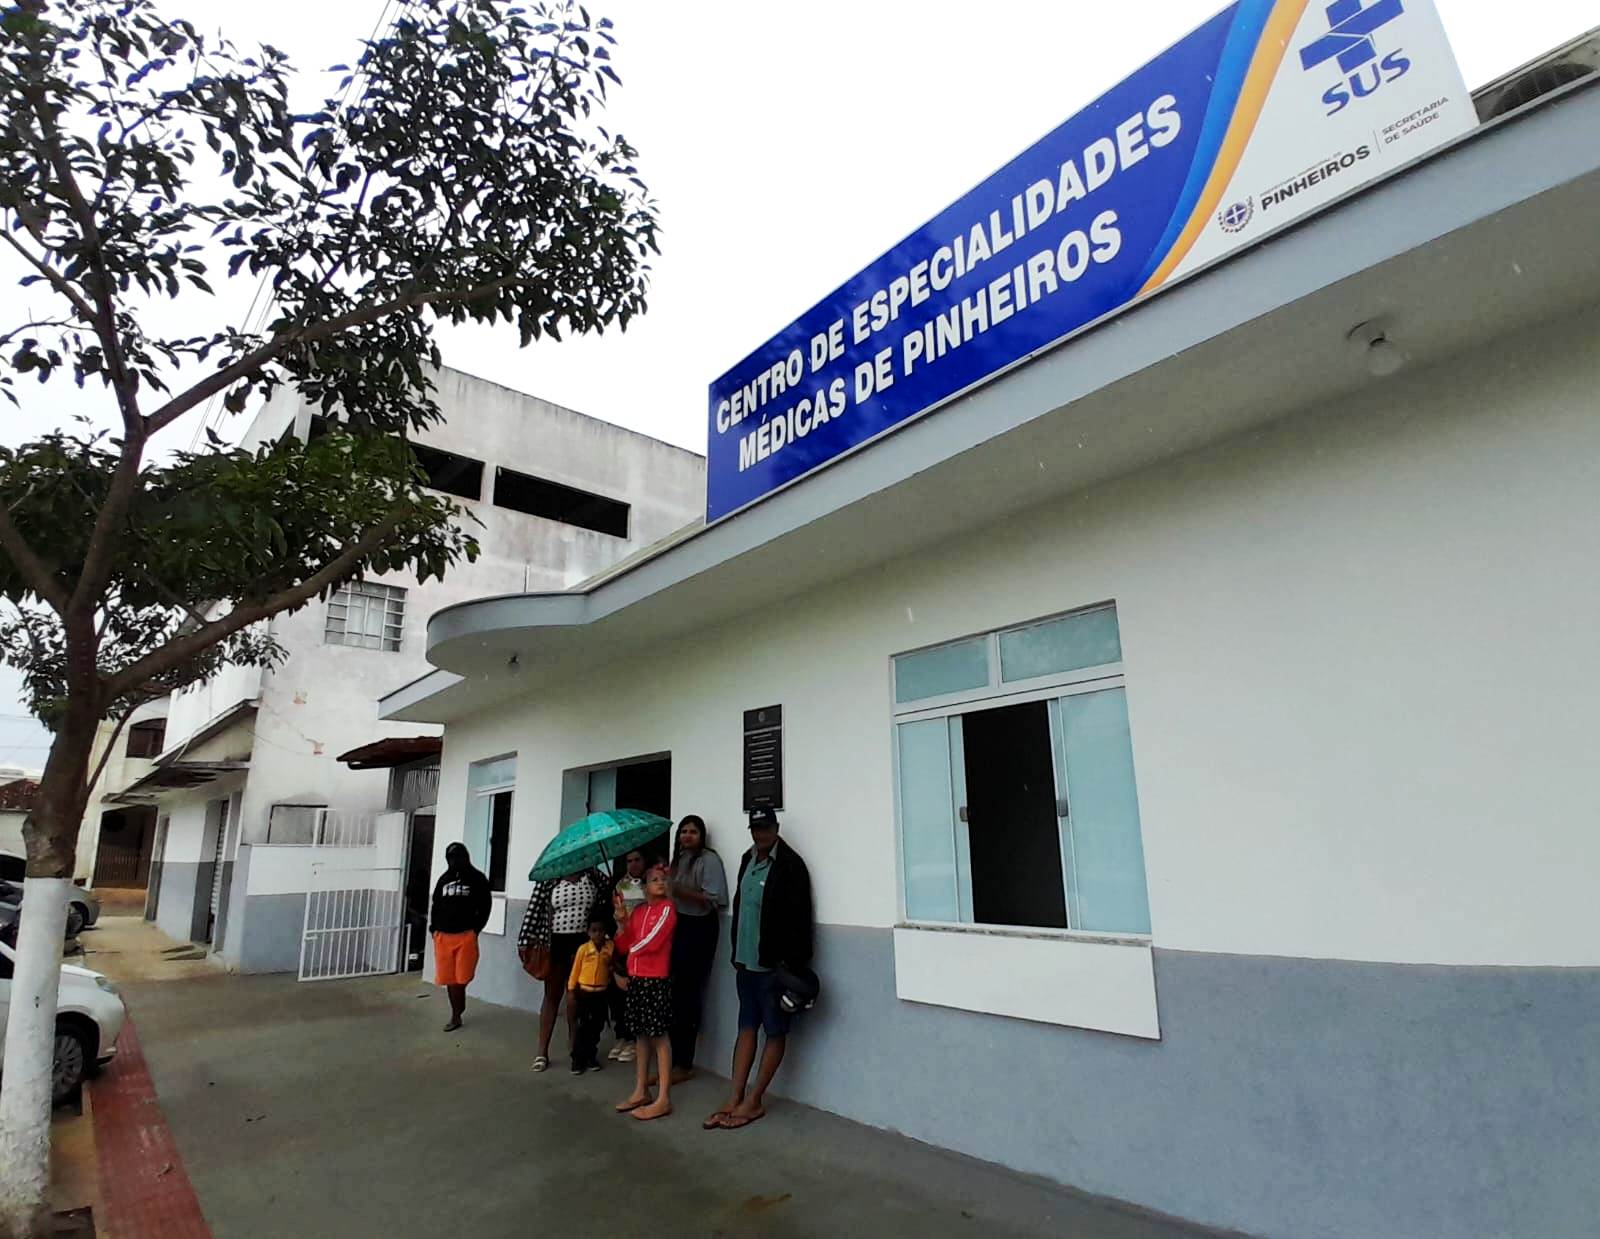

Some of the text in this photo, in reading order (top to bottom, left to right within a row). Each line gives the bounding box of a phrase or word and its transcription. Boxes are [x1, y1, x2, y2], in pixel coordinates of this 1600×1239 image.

[1322, 48, 1411, 117] SUS
[1381, 96, 1449, 135] SECRETARIA
[1384, 132, 1400, 145] DE
[1260, 145, 1370, 210] PINHEIROS
[716, 348, 803, 434] CENTRO
[811, 318, 846, 373] DE
[853, 93, 1182, 345] ESPECIALIDADES
[739, 209, 1122, 473] MÉDICAS DE PINHEIROS
